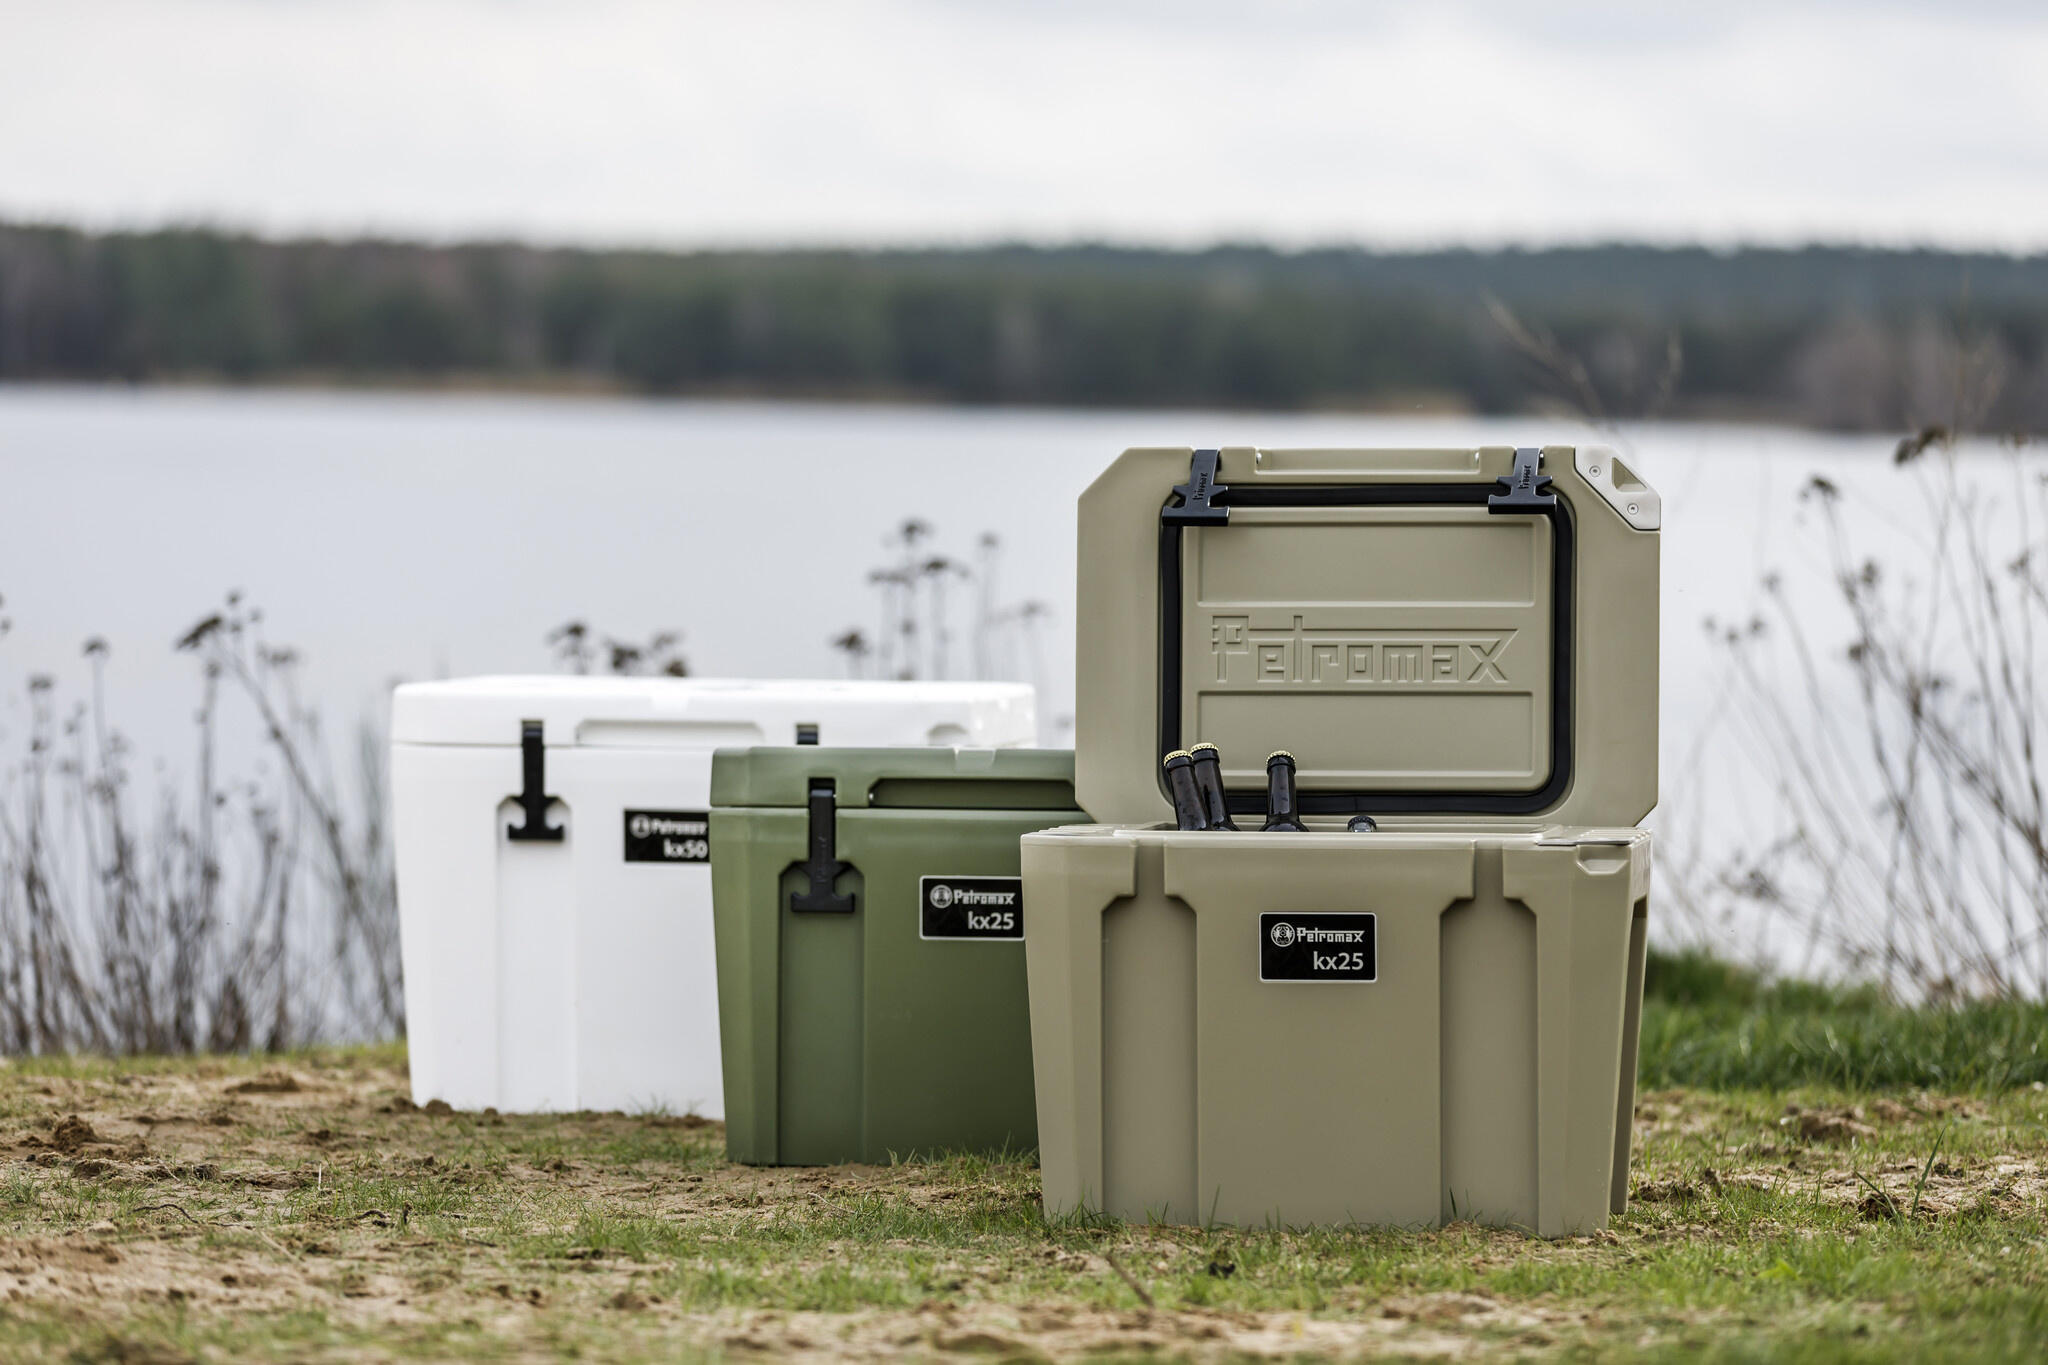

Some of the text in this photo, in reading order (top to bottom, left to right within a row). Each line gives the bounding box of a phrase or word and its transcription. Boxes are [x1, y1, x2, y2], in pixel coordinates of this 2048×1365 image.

[1212, 615, 1519, 683] Petromax
[663, 838, 708, 858] kx50
[953, 889, 1015, 905] Petromax
[967, 910, 1015, 930] kx25
[1296, 927, 1365, 943] Petromax
[1313, 950, 1364, 970] kx25
